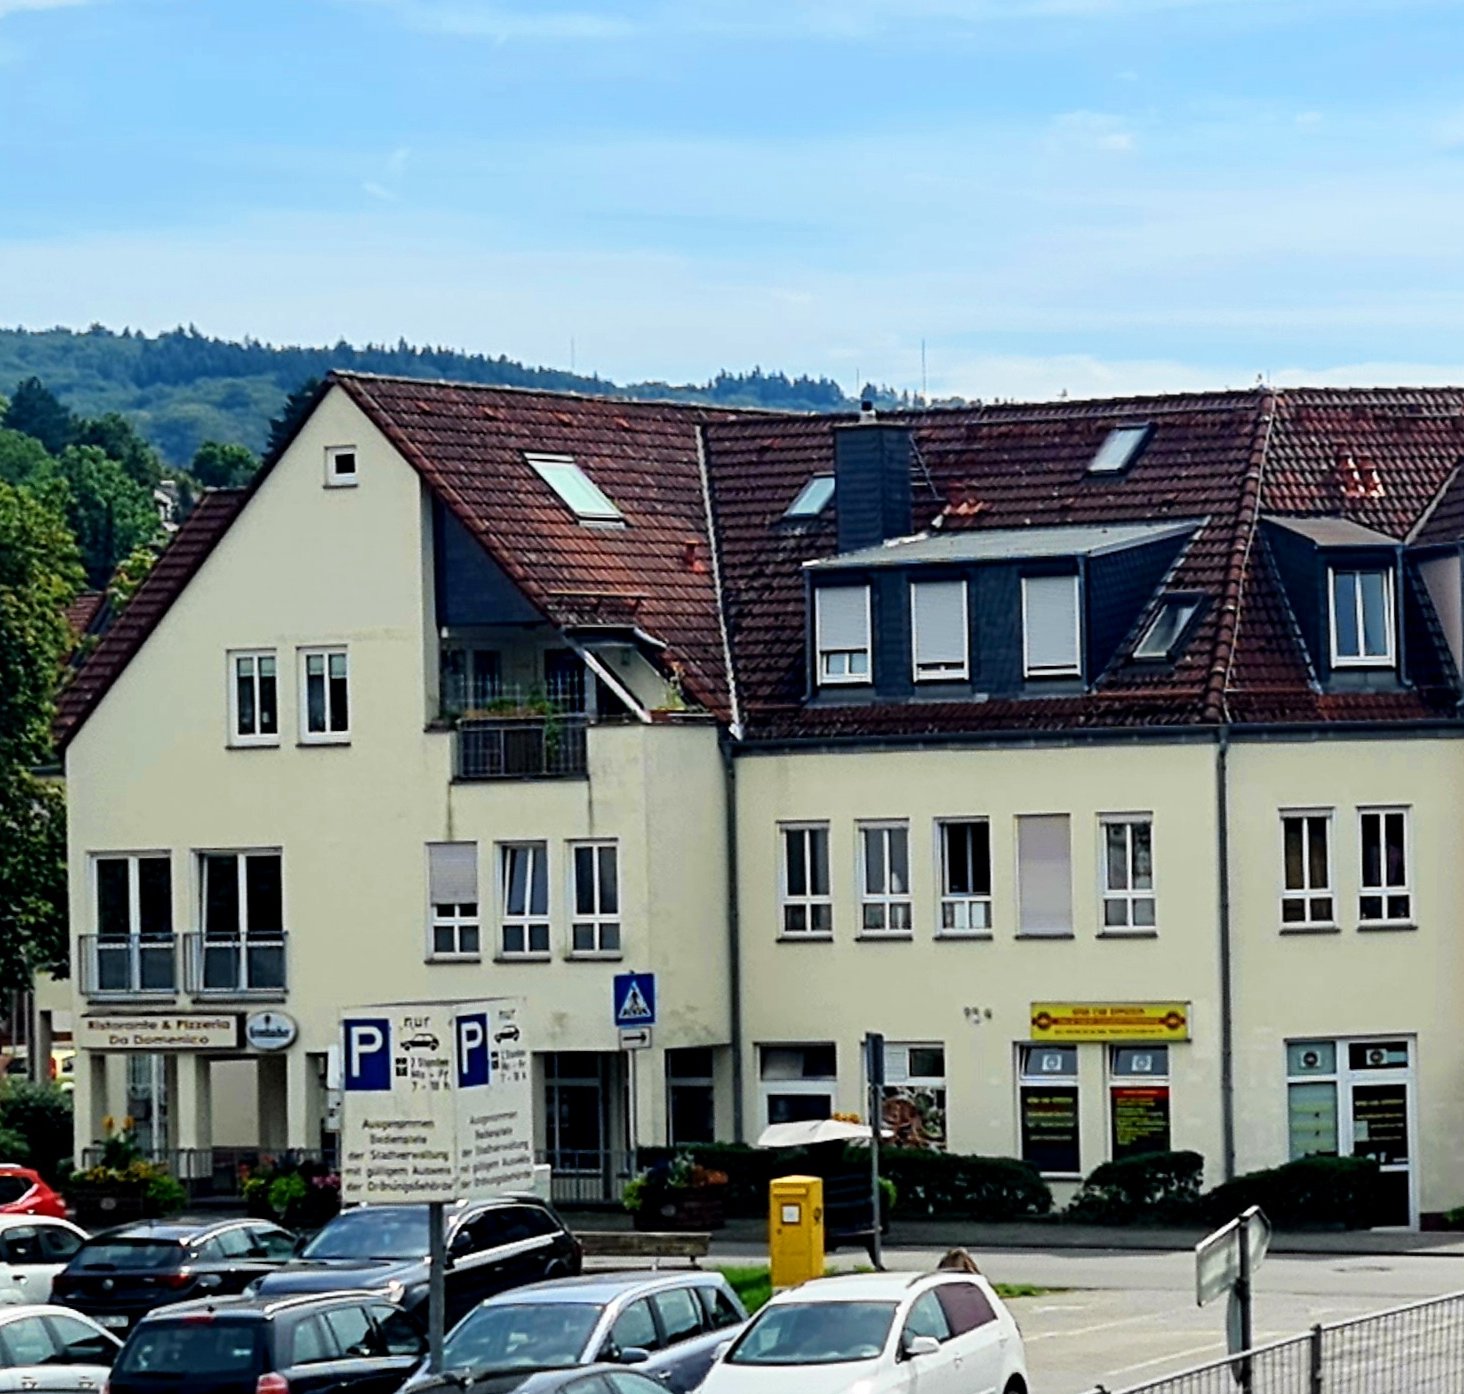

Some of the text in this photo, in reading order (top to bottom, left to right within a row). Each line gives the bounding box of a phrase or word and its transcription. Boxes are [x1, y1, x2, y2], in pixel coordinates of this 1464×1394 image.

[88, 1020, 156, 1031] Ristorante
[177, 1019, 230, 1030] Pizzeria
[403, 1016, 430, 1028] nur
[134, 1033, 209, 1045] Domenico
[350, 1026, 384, 1077] P
[460, 1021, 483, 1075] P
